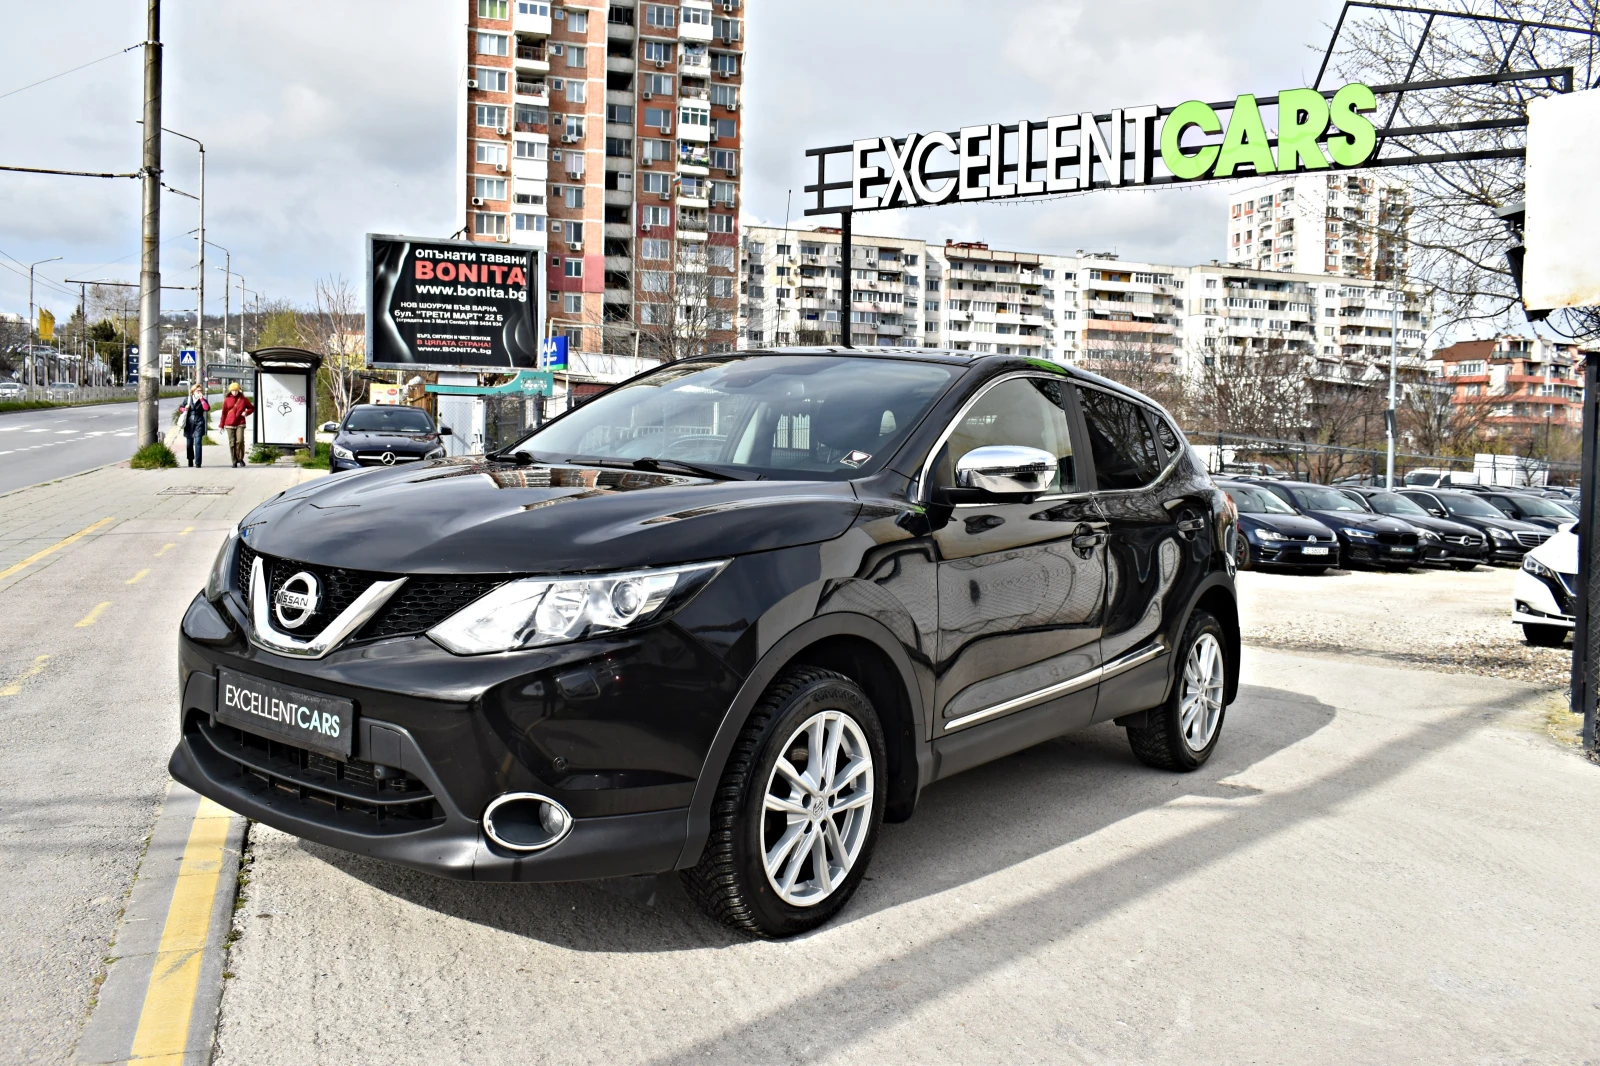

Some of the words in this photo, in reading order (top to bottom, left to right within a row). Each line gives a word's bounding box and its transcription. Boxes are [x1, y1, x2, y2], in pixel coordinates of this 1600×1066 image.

[415, 249, 476, 261] опънати
[480, 253, 527, 265] тавани
[415, 260, 527, 286] BONITA
[415, 285, 527, 302] www.bonita.bg
[419, 302, 452, 310] ШОУРУМ
[394, 310, 414, 318] бул.
[496, 314, 503, 322] Б
[417, 346, 492, 355] www.BONITA.bg
